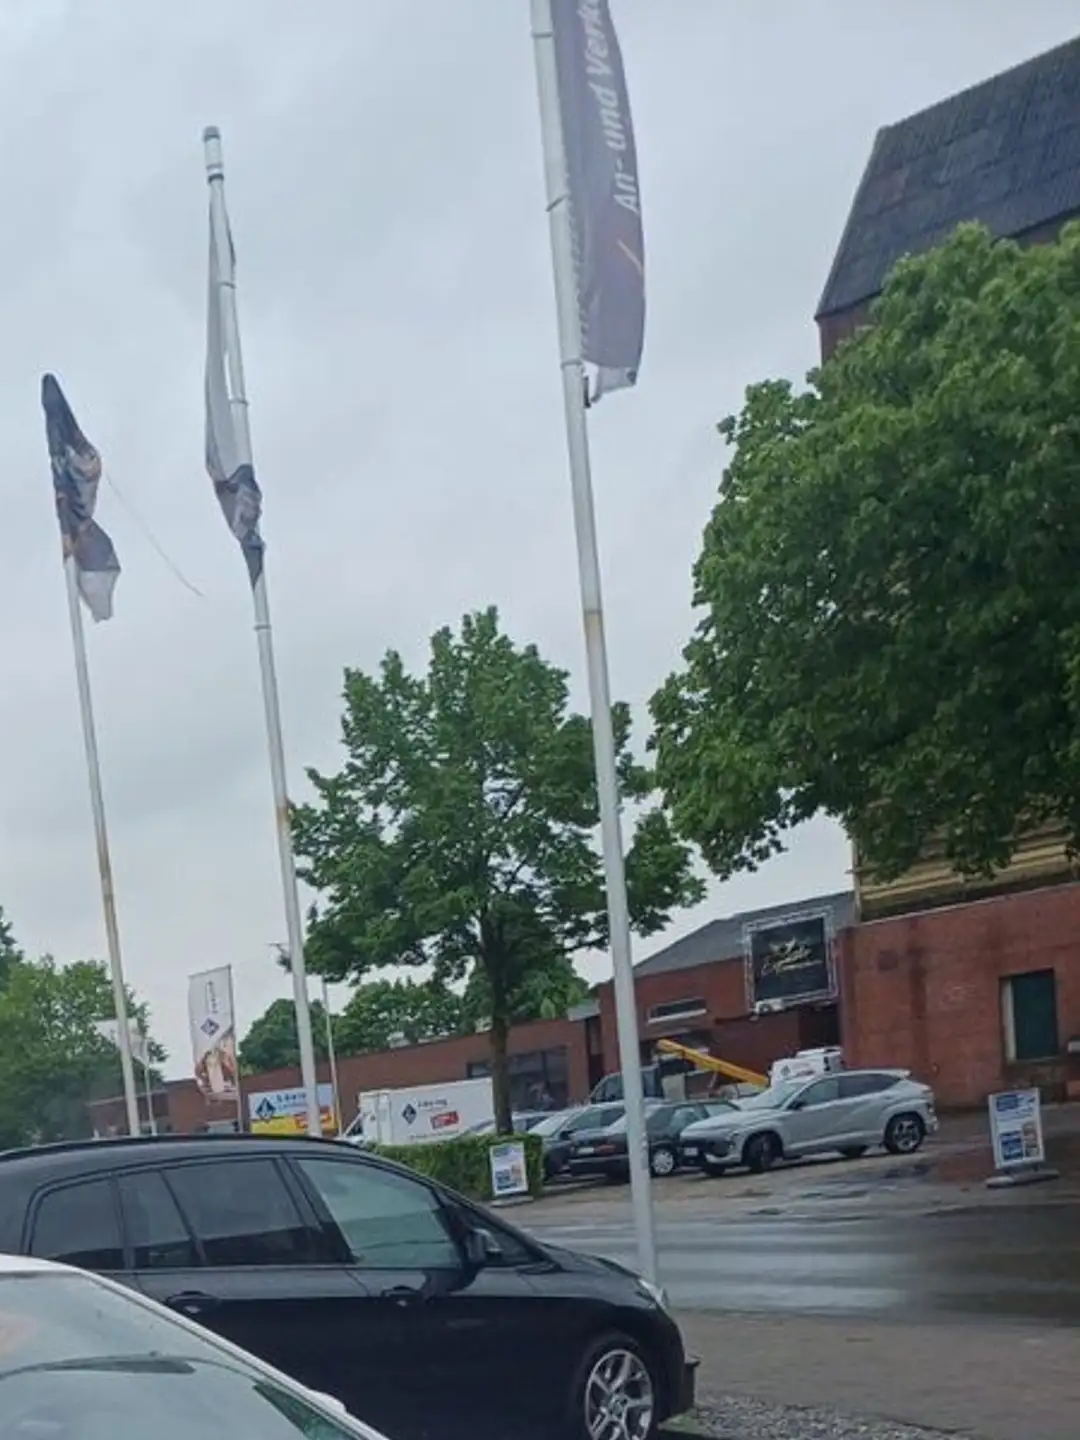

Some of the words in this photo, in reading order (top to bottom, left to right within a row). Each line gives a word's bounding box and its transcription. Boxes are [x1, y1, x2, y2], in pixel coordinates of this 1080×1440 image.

[577, 0, 613, 76] Verk
[589, 82, 626, 151] und
[613, 158, 640, 217] An-
